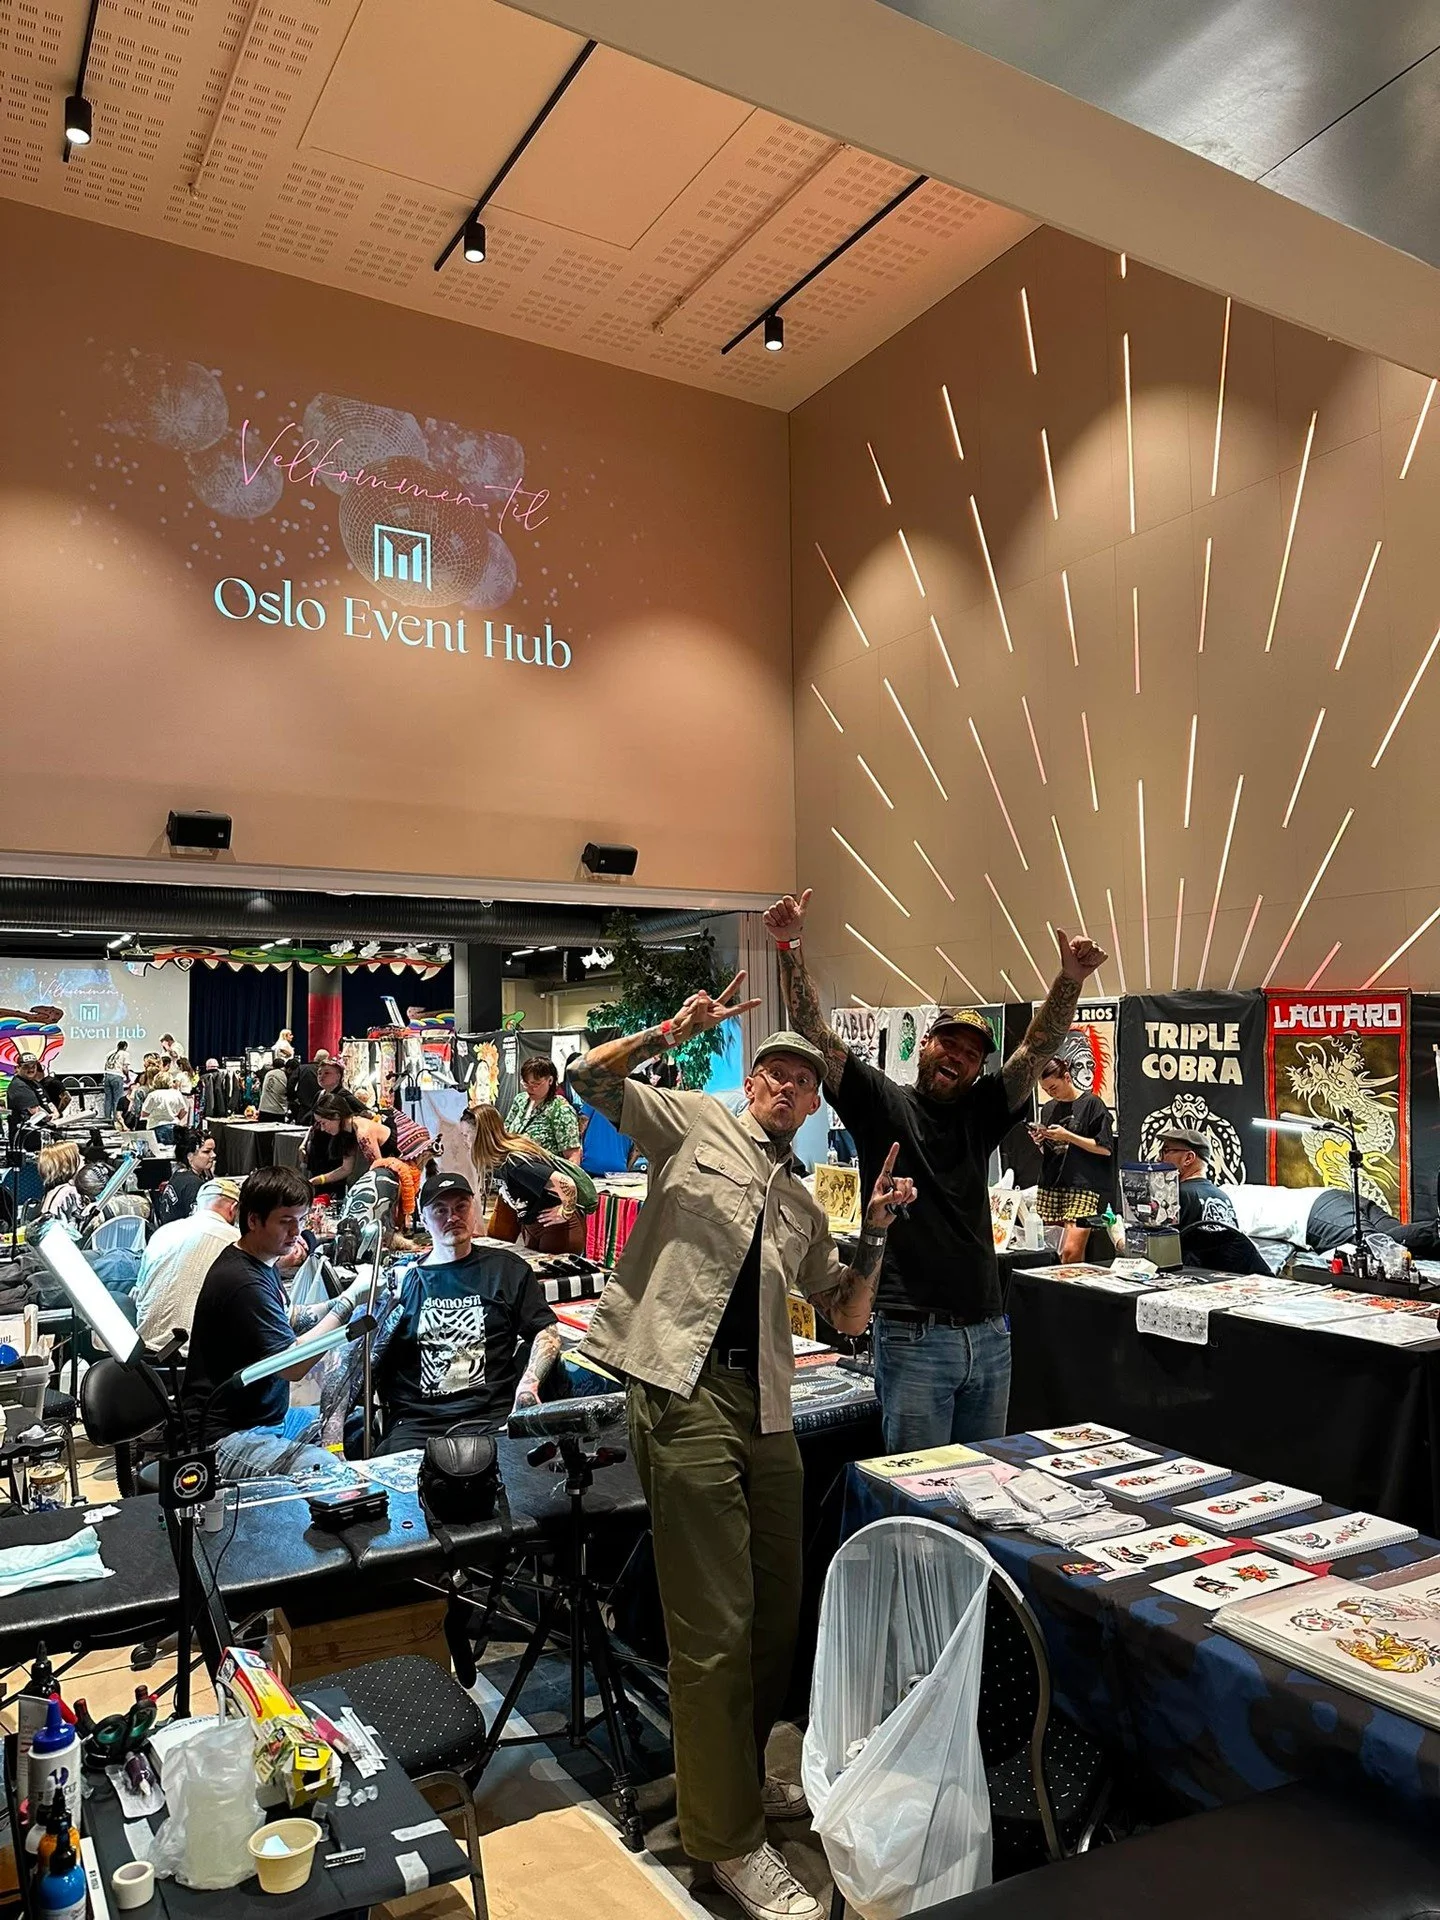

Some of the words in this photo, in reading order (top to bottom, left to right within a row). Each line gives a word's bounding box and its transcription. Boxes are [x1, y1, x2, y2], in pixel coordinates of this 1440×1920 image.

[241, 419, 489, 507] Velkommen
[213, 577, 327, 631] Oslo
[343, 596, 469, 654] Event
[483, 622, 572, 669] Hub
[836, 1012, 876, 1041] PABLO
[1081, 1007, 1113, 1022] RIOS
[1273, 1002, 1402, 1029] LAUTARO
[70, 1025, 110, 1039] Event
[115, 1024, 147, 1039] Hub
[1144, 1021, 1241, 1051] TRIPLE
[1141, 1053, 1243, 1086] COBRA
